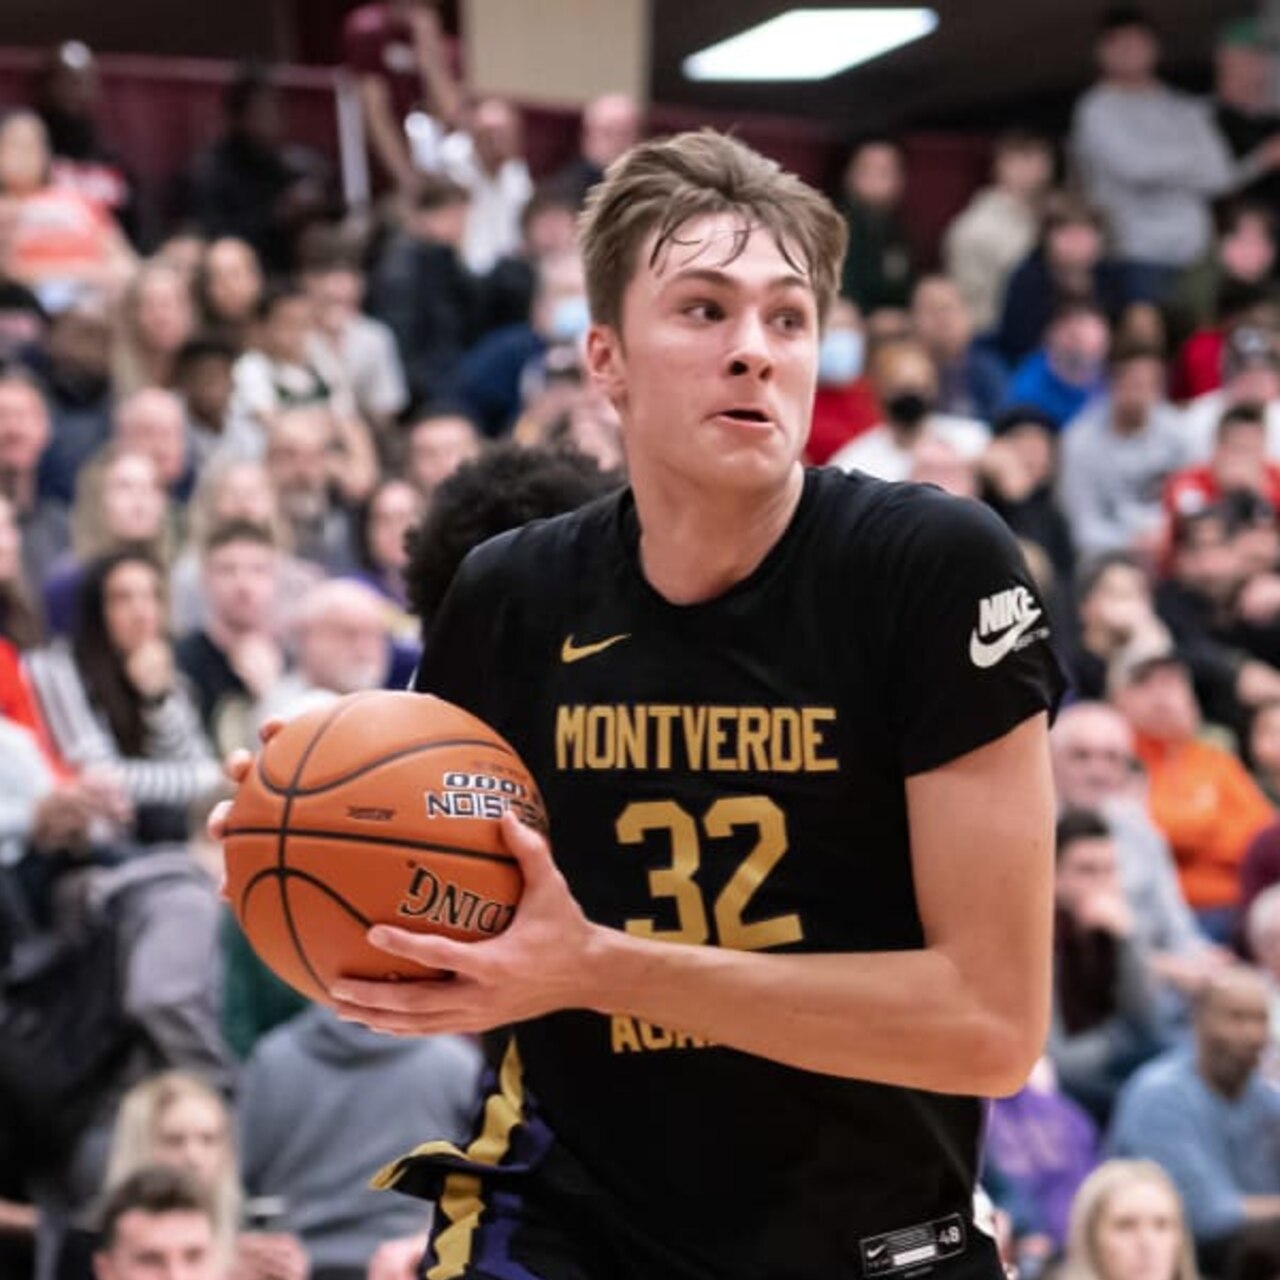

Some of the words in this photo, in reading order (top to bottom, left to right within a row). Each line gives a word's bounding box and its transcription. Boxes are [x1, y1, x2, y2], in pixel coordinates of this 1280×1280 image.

[978, 585, 1035, 637] NIKE
[556, 705, 839, 773] MONTVERDE
[400, 866, 517, 935] LDING
[615, 796, 804, 951] 32
